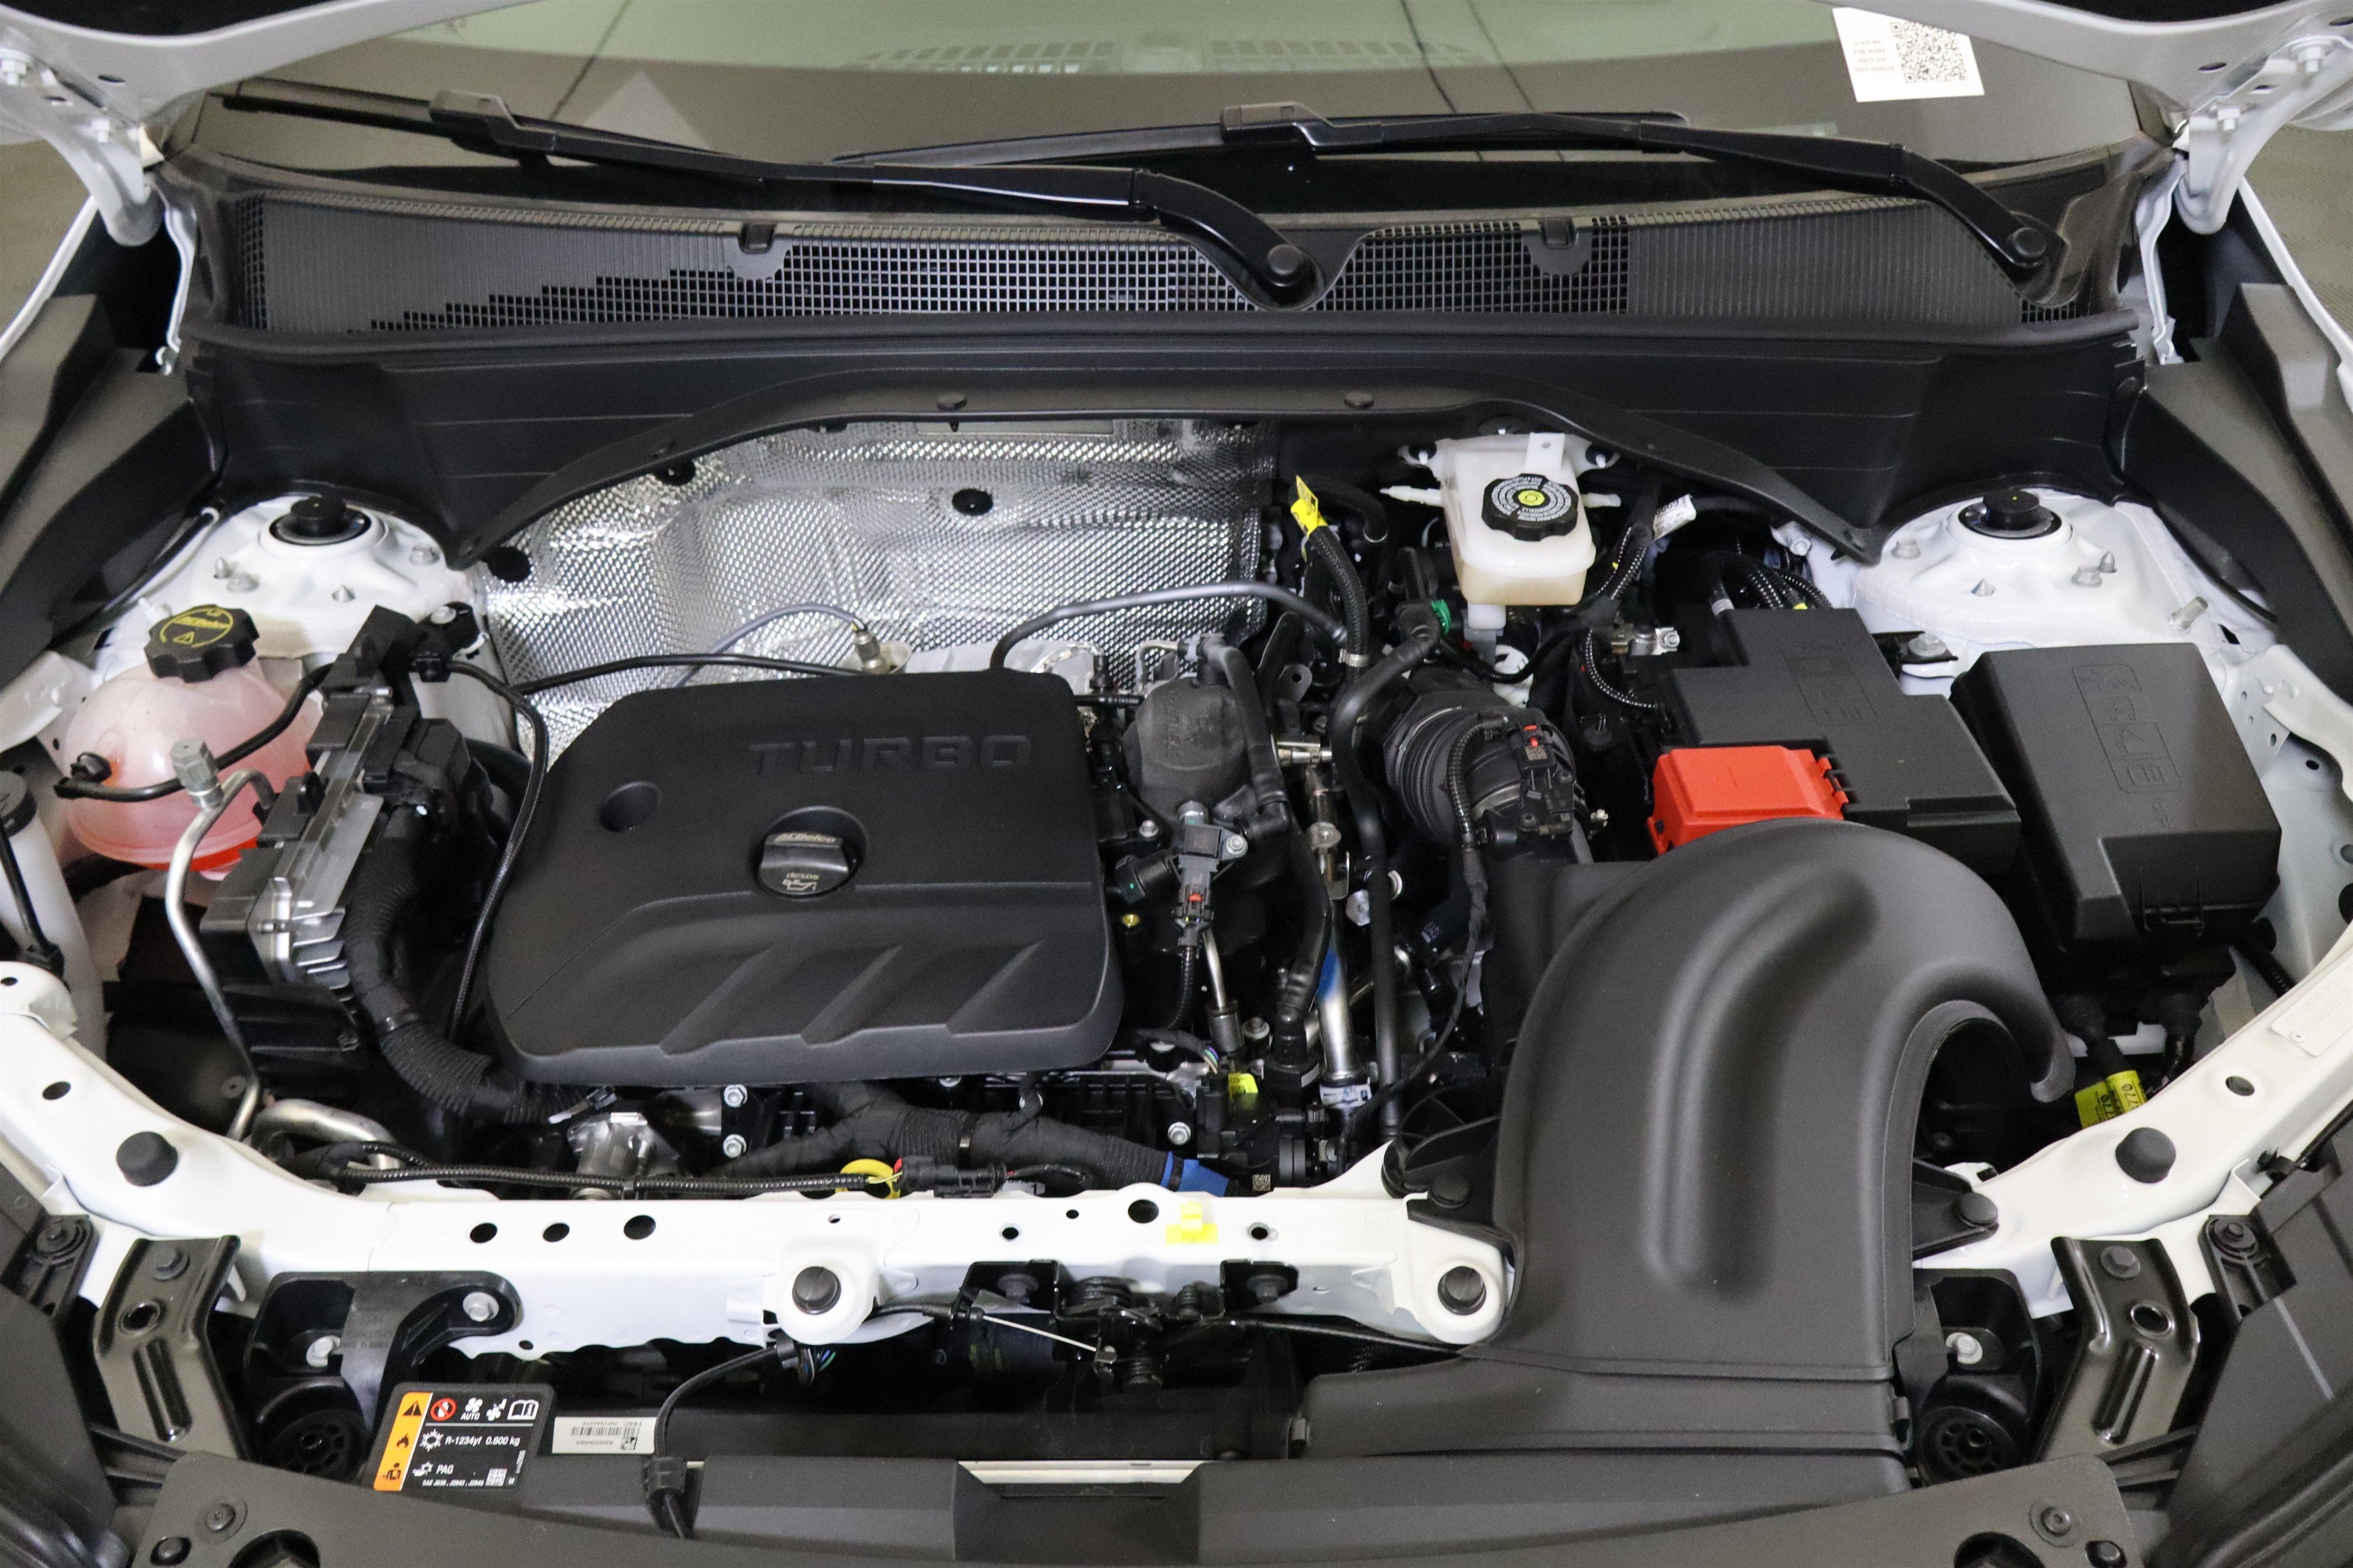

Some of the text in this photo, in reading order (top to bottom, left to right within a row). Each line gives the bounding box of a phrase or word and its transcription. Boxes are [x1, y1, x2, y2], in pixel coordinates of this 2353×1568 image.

[746, 735, 1031, 775] TURBO
[460, 1412, 480, 1420] AUTO
[445, 1436, 520, 1447] R-1234yf 0.600 kg
[436, 1464, 454, 1474] PAG
